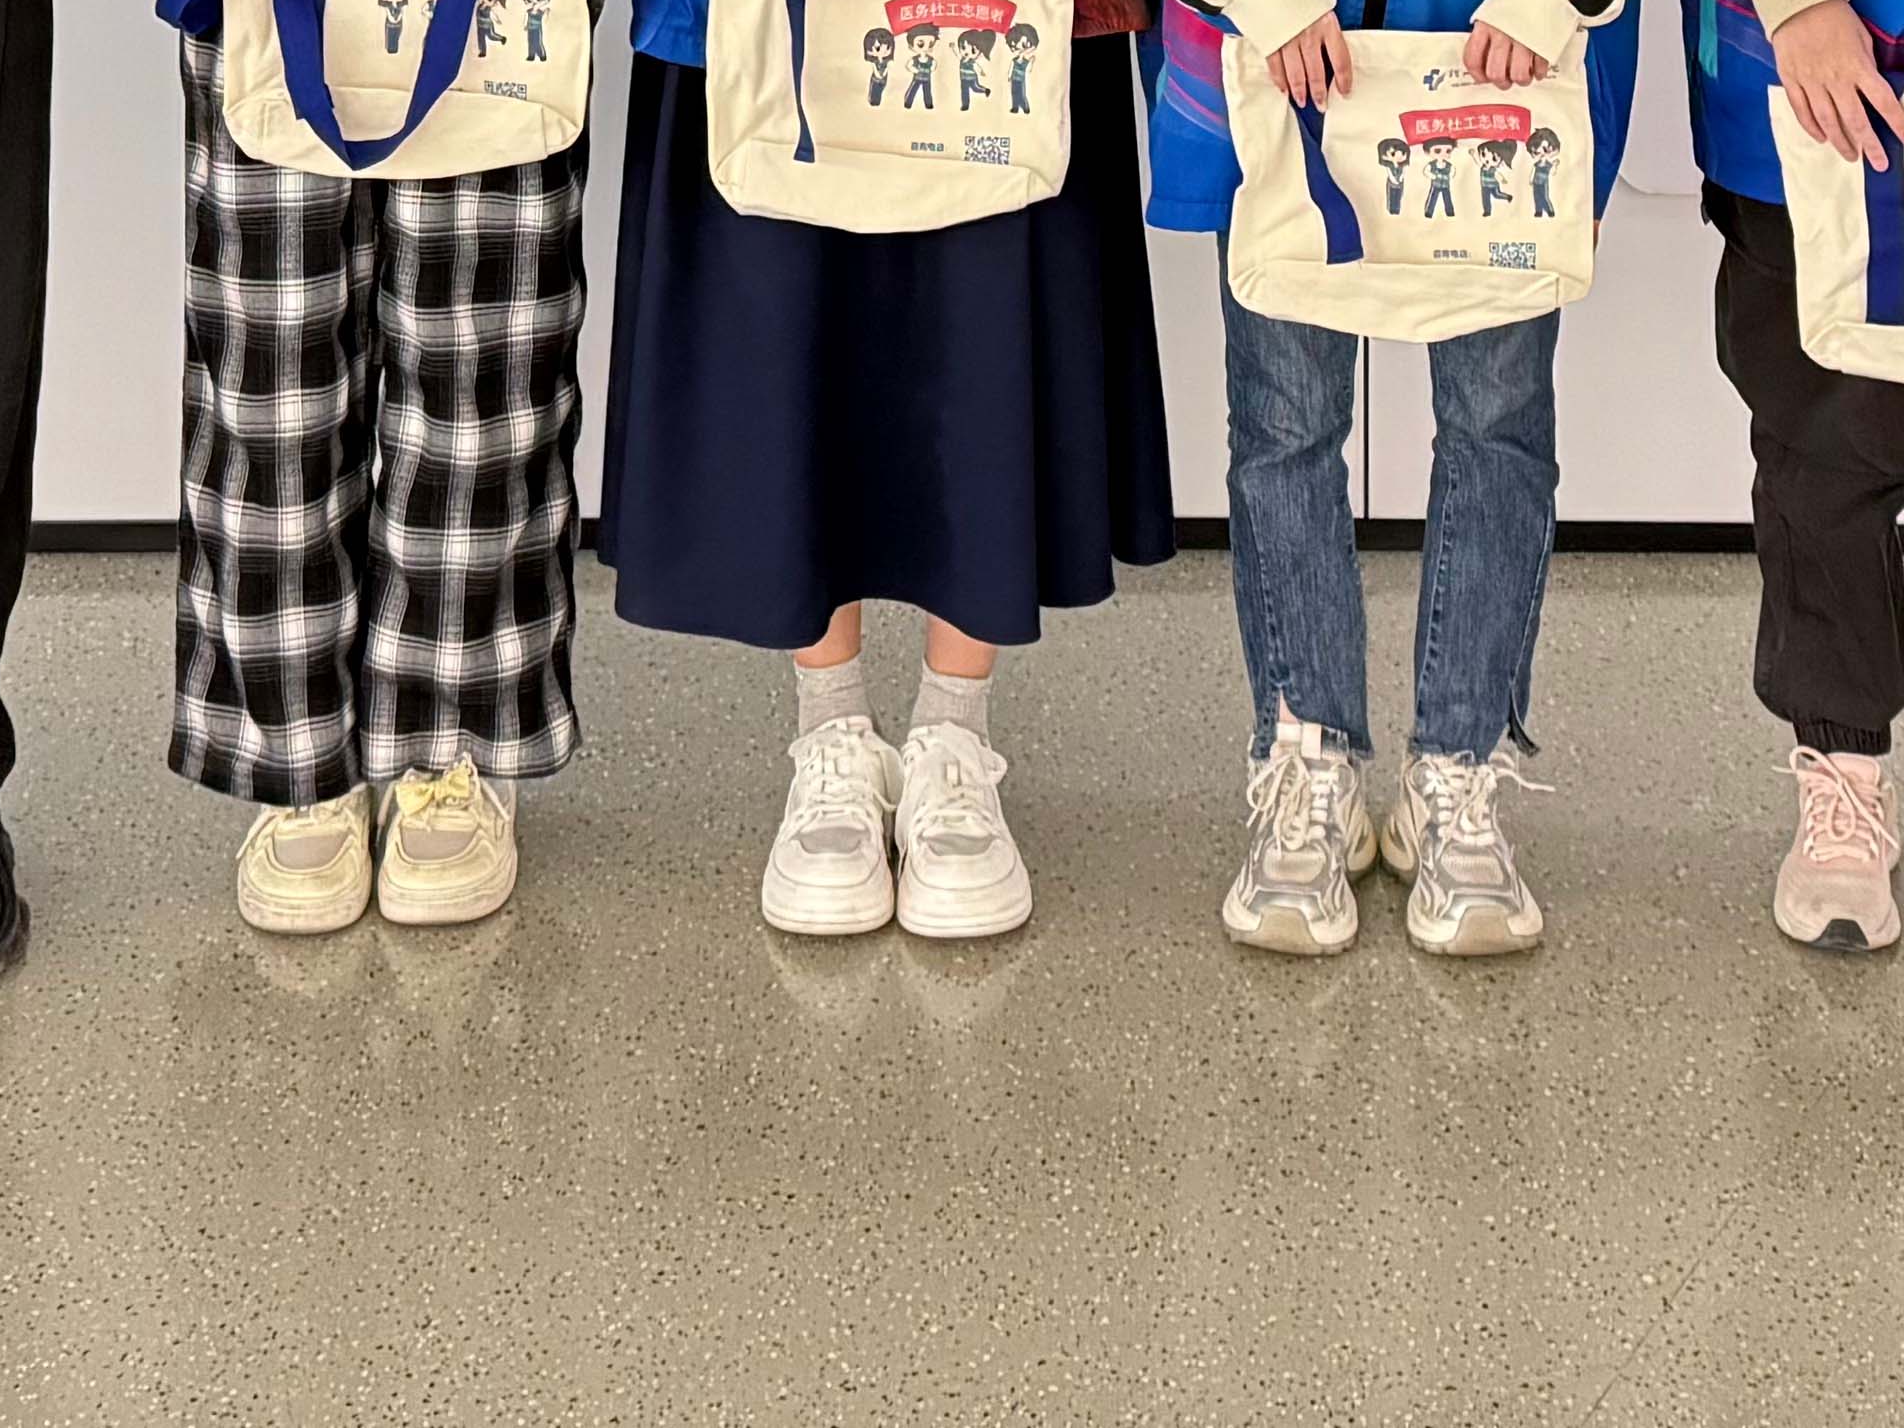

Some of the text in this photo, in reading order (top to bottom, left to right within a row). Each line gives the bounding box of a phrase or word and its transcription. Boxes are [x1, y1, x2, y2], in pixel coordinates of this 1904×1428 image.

[900, 2, 1005, 24] 医务社工志愿者
[1415, 113, 1521, 135] 医务社工志愿者
